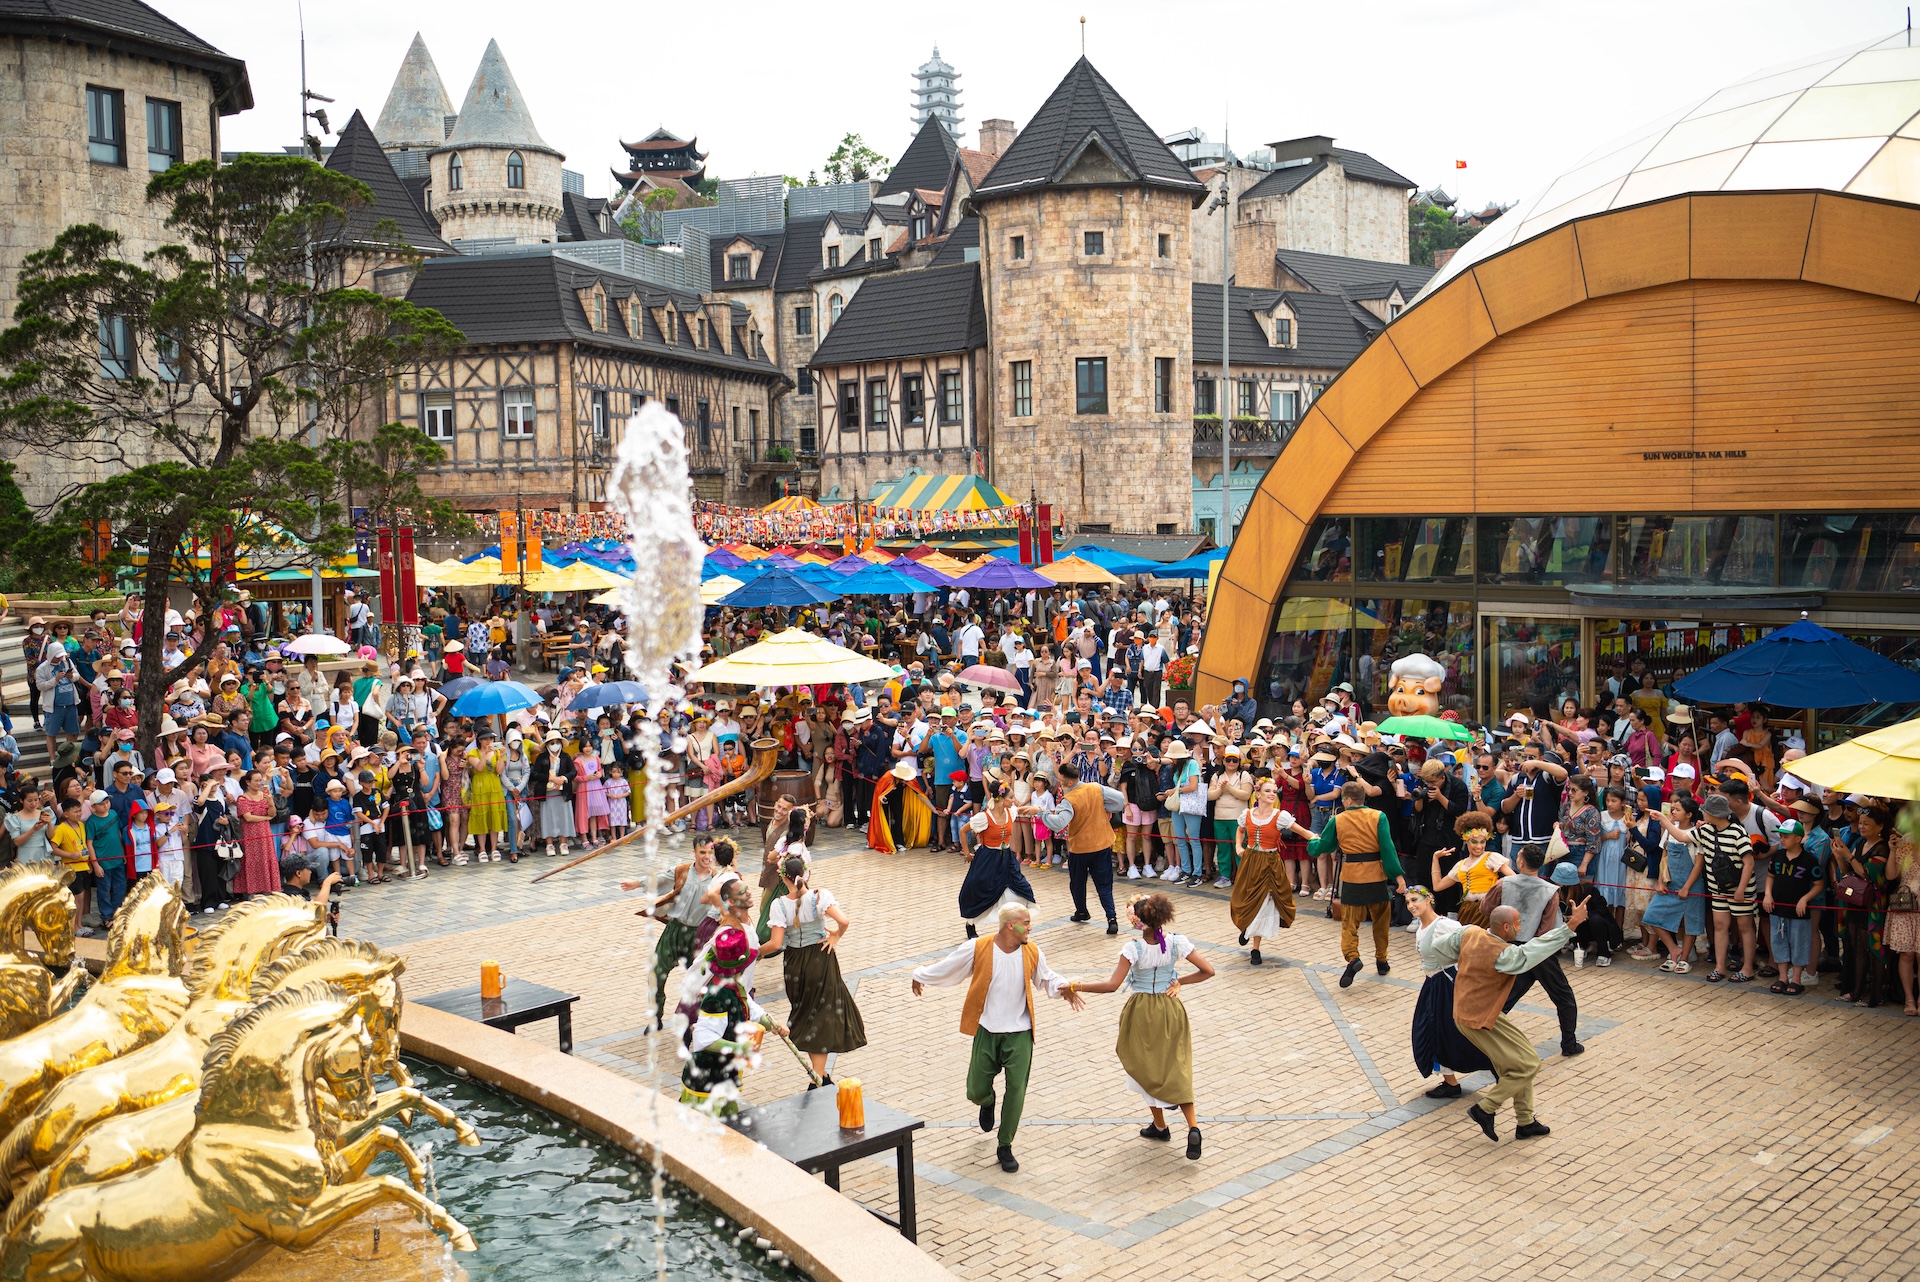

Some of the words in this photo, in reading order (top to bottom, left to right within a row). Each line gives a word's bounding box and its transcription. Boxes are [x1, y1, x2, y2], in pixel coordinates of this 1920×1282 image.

[1643, 453, 1661, 461] SUN
[1662, 452, 1693, 460] WORLD
[1708, 451, 1722, 459] NA
[1725, 450, 1747, 458] HILLS
